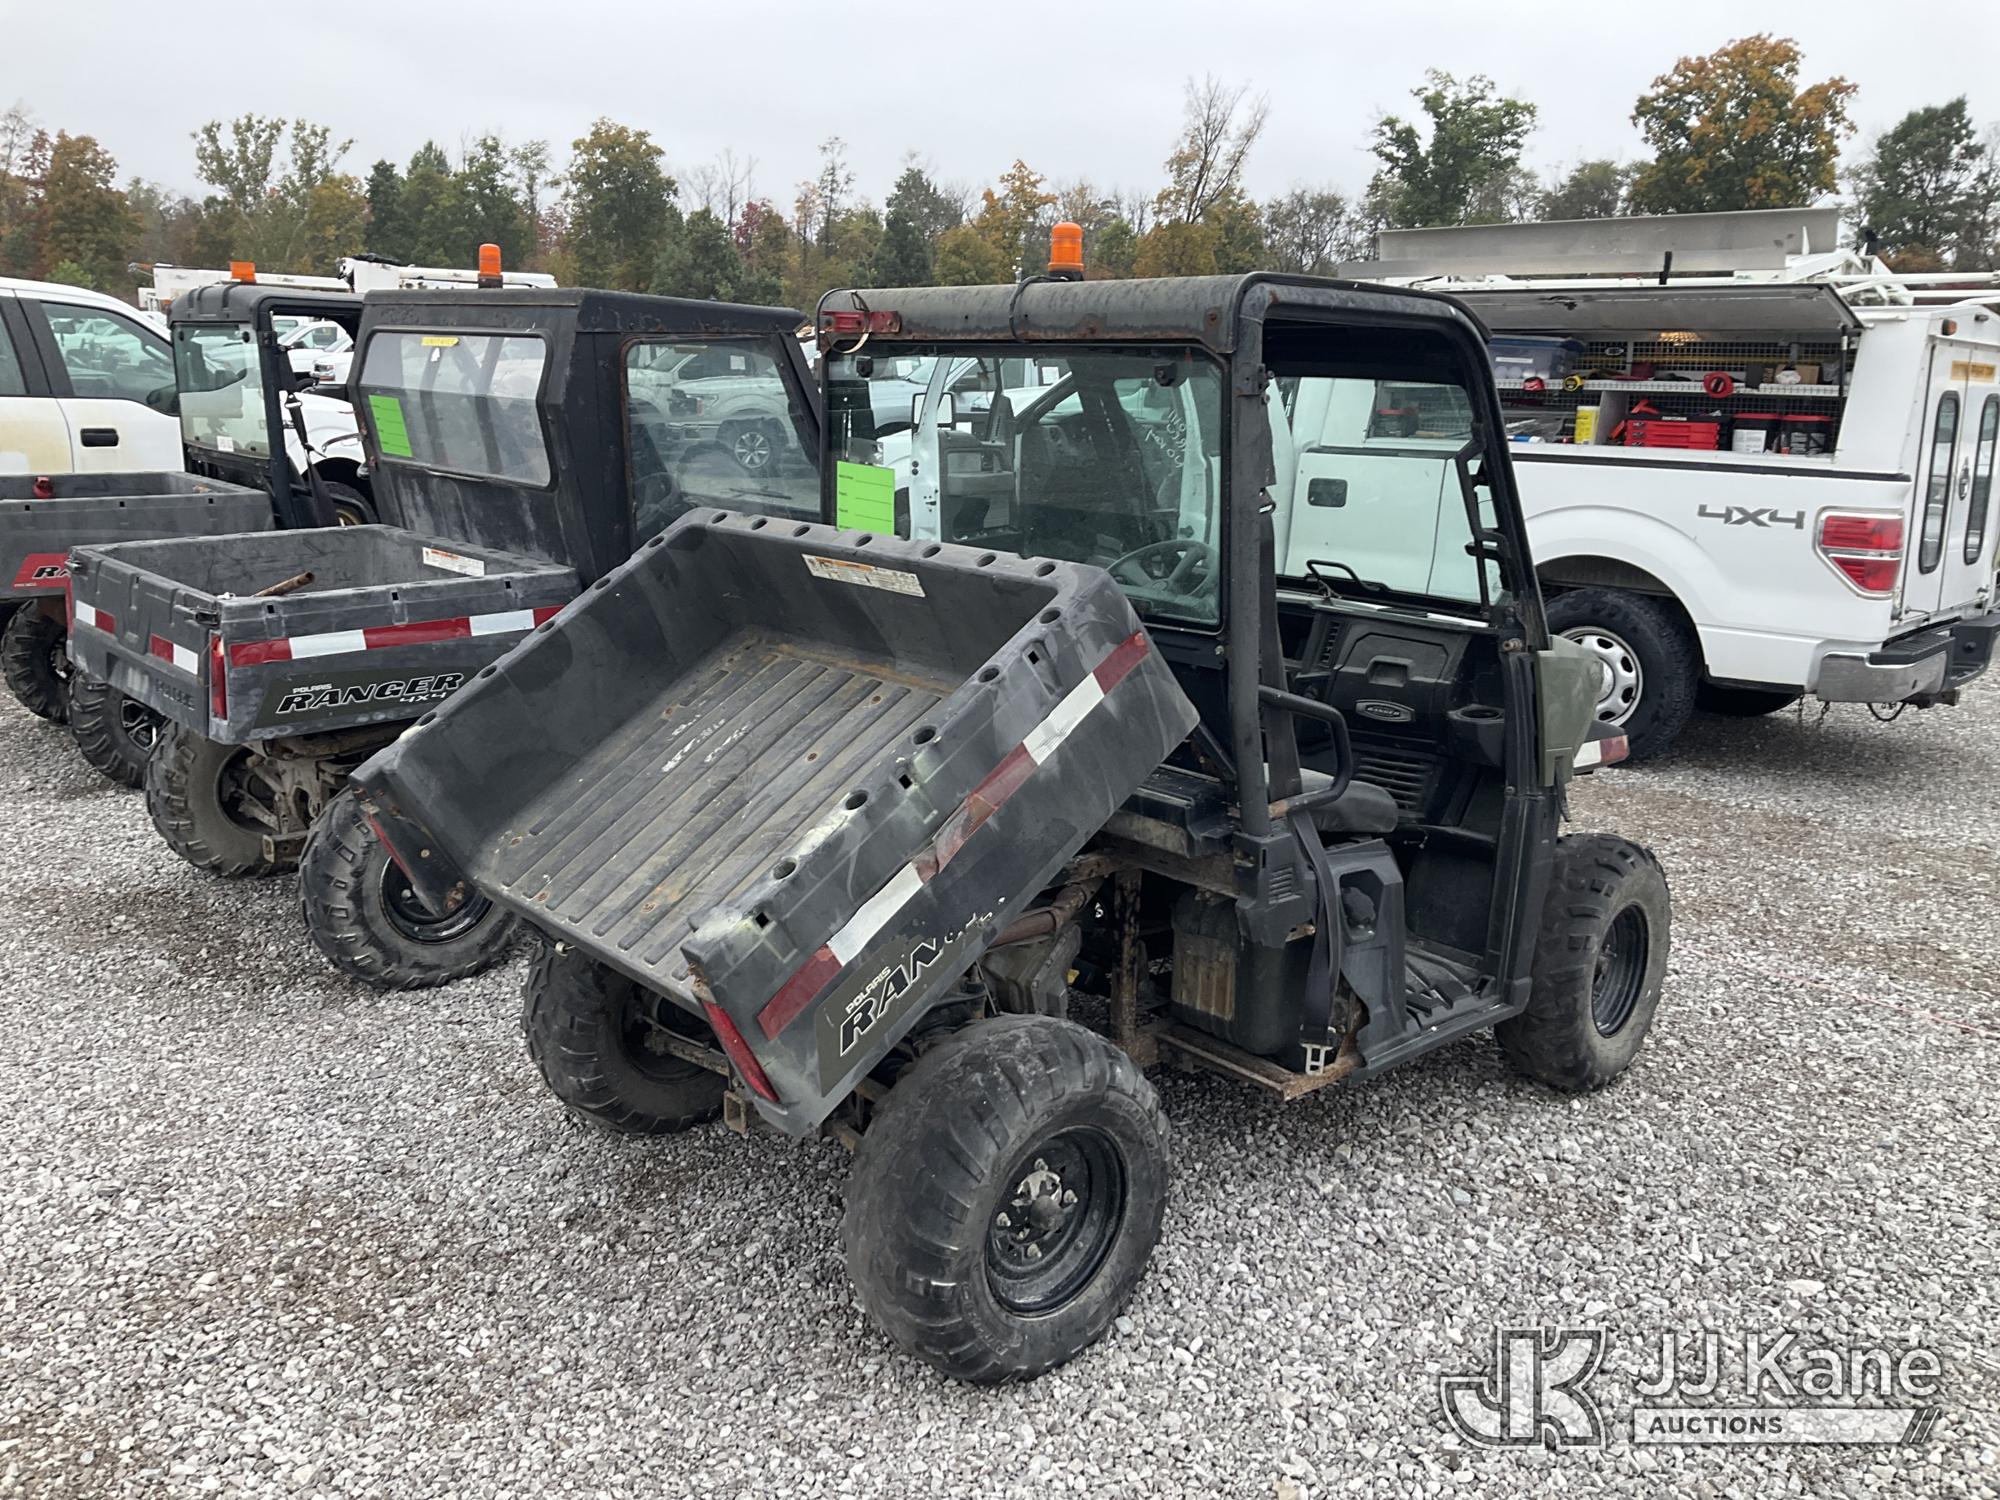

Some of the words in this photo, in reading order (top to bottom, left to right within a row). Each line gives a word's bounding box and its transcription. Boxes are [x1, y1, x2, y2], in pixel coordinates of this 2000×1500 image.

[275, 673, 465, 714] RANGER
[292, 683, 332, 694] POLARIS
[845, 966, 891, 1014] POLARIS
